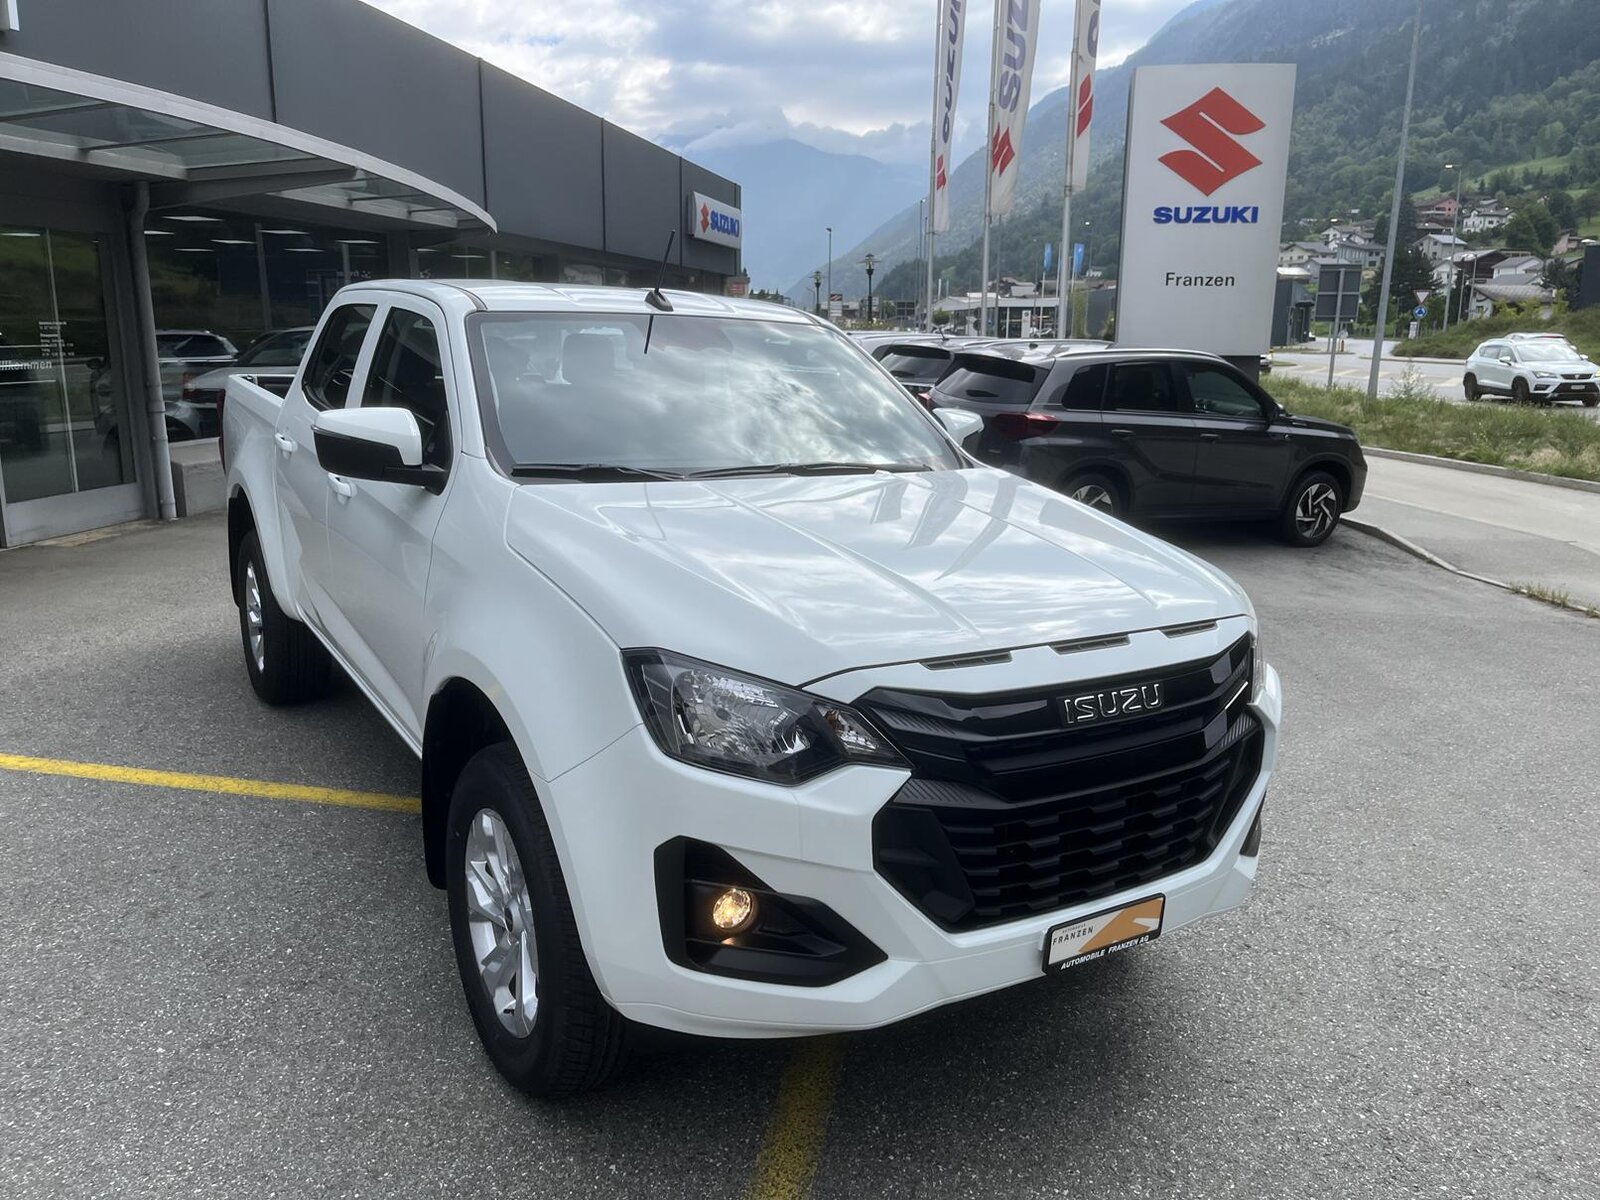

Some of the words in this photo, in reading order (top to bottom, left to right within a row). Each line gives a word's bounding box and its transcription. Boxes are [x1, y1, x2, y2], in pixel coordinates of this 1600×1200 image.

[1153, 206, 1259, 224] SUZUKI
[1165, 272, 1235, 287] Franzen
[1064, 684, 1161, 723] ISUZU
[1053, 926, 1094, 945] FRANZEN
[1061, 949, 1105, 970] AUTOMOBILE
[1108, 938, 1139, 954] FRANZEN
